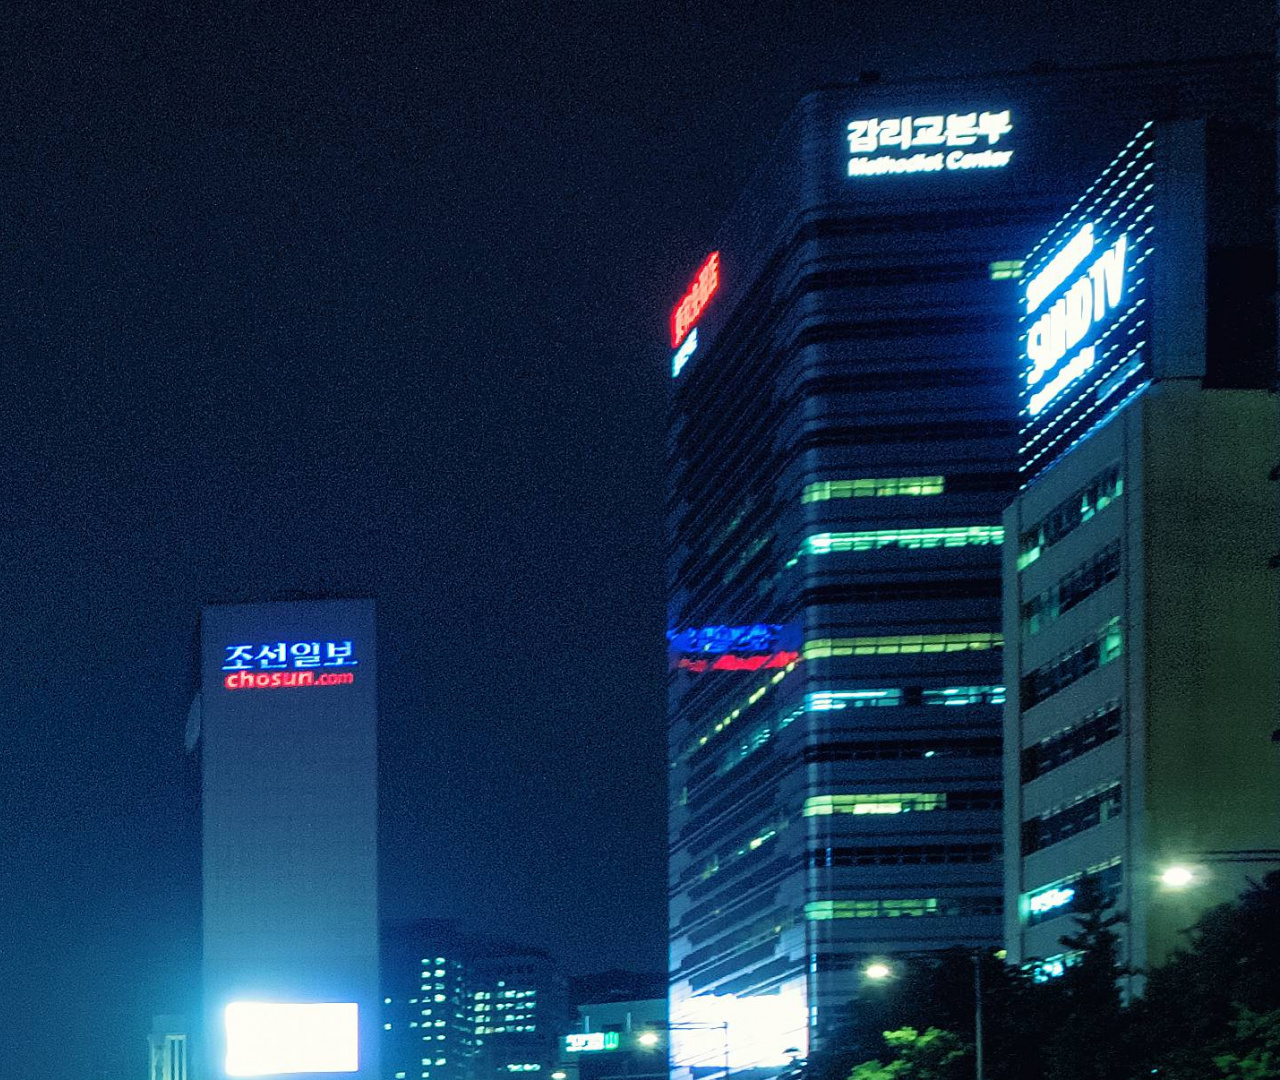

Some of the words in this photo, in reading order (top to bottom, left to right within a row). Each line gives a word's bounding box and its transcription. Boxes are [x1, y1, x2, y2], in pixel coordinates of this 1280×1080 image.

[847, 109, 1013, 153] 감리교본부
[221, 640, 359, 671] 조선일보
[225, 671, 354, 689] chosun.com
